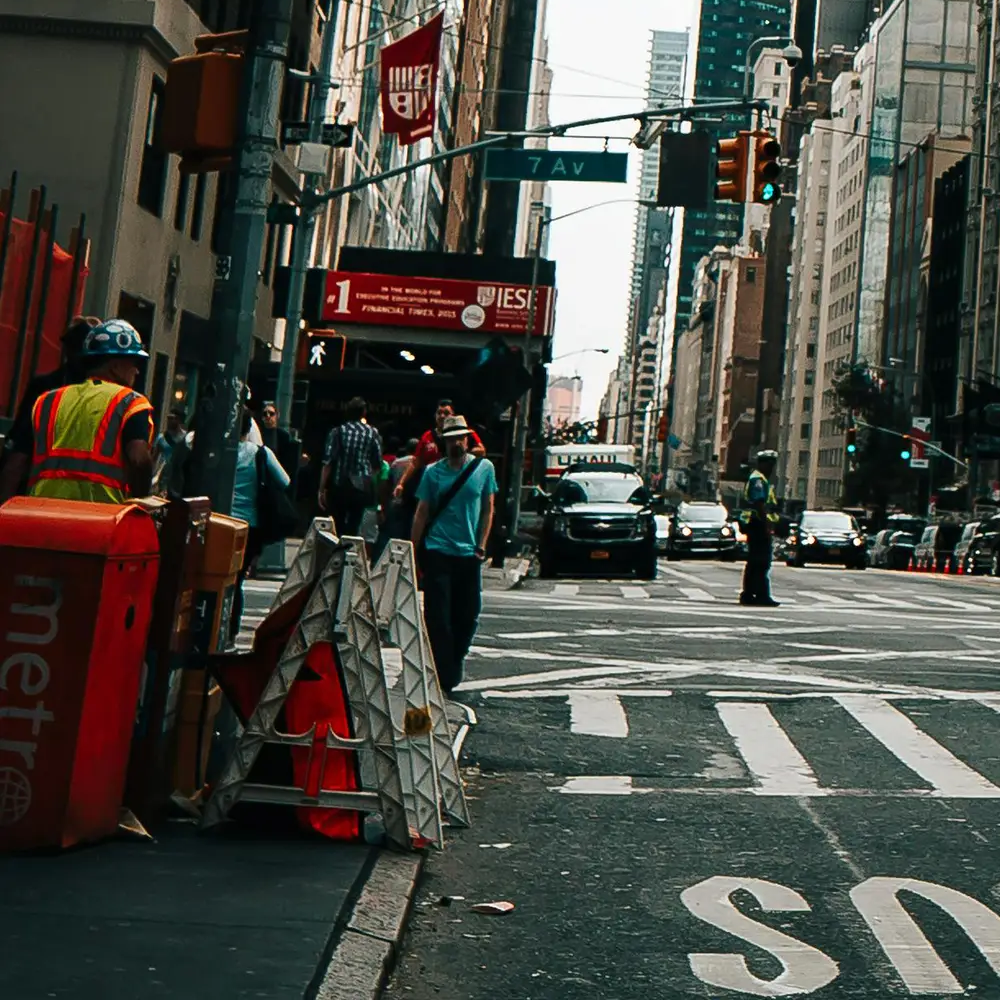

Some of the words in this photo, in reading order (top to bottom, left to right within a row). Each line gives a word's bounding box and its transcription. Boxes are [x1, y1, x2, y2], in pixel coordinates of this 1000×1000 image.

[528, 156, 542, 174] 7
[551, 157, 584, 175] Av
[326, 279, 352, 314] #1
[404, 287, 428, 296] WORLD
[361, 304, 405, 315] FINANCIAL
